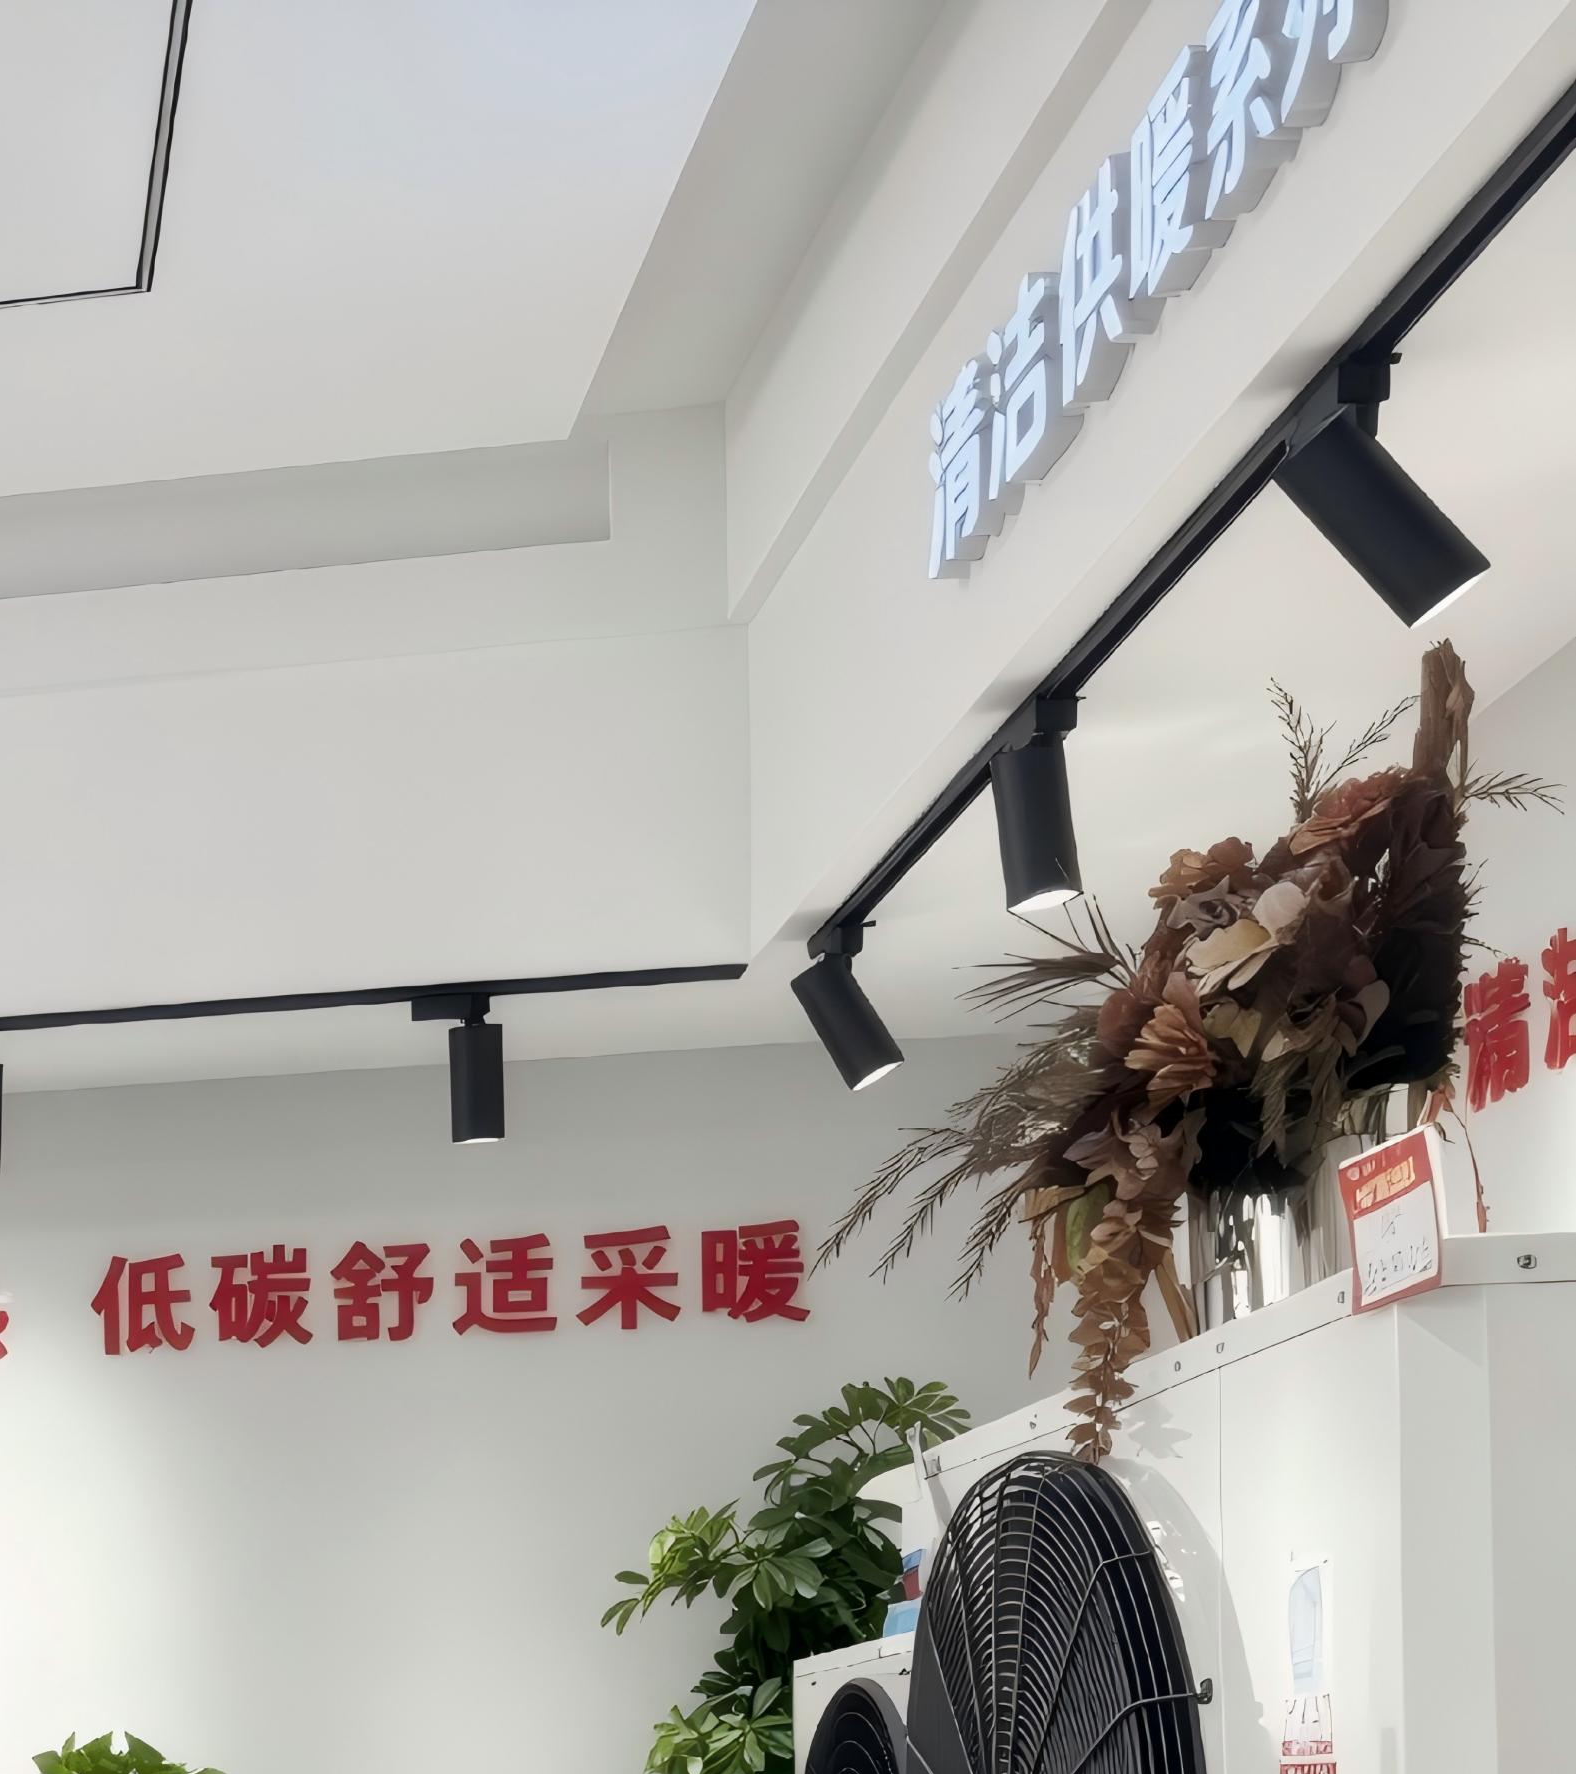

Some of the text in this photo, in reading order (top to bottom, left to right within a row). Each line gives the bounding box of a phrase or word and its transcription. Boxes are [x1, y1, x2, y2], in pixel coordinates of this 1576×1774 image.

[90, 1219, 811, 1356] 低碳舒适采暖
